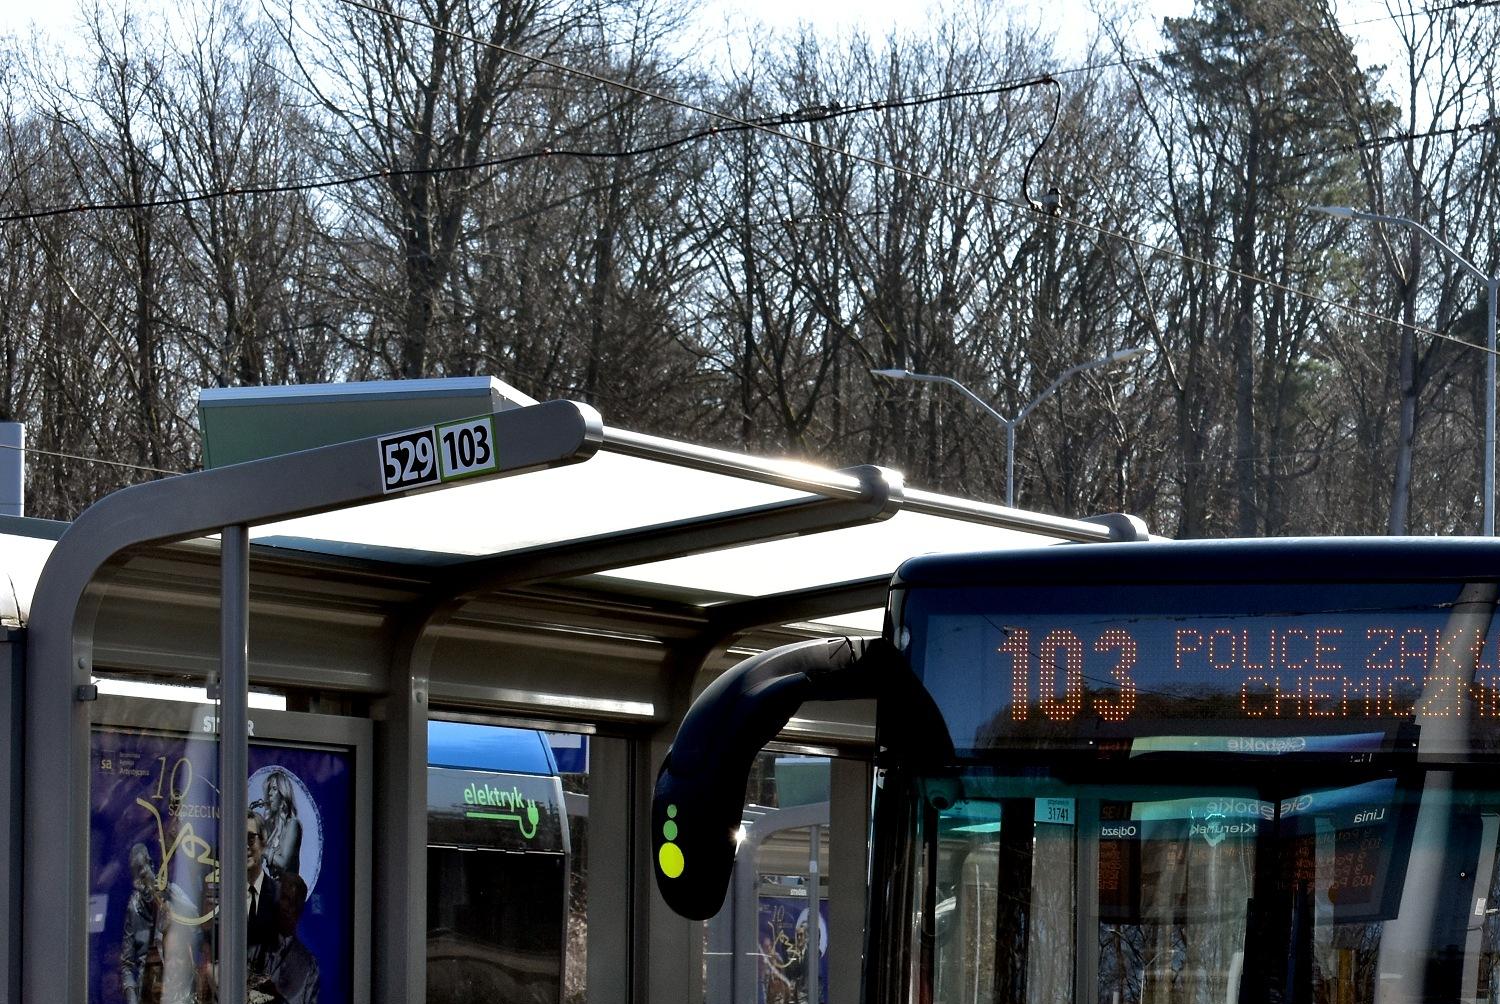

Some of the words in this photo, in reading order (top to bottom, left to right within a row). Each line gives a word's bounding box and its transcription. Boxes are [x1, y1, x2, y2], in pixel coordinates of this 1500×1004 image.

[385, 436, 434, 485] 529
[443, 425, 491, 470] 103
[1176, 629, 1343, 669] POLICE
[998, 629, 1137, 721] 103
[151, 756, 193, 800] 10
[463, 783, 525, 813] elektryk
[1047, 807, 1069, 821] 31741
